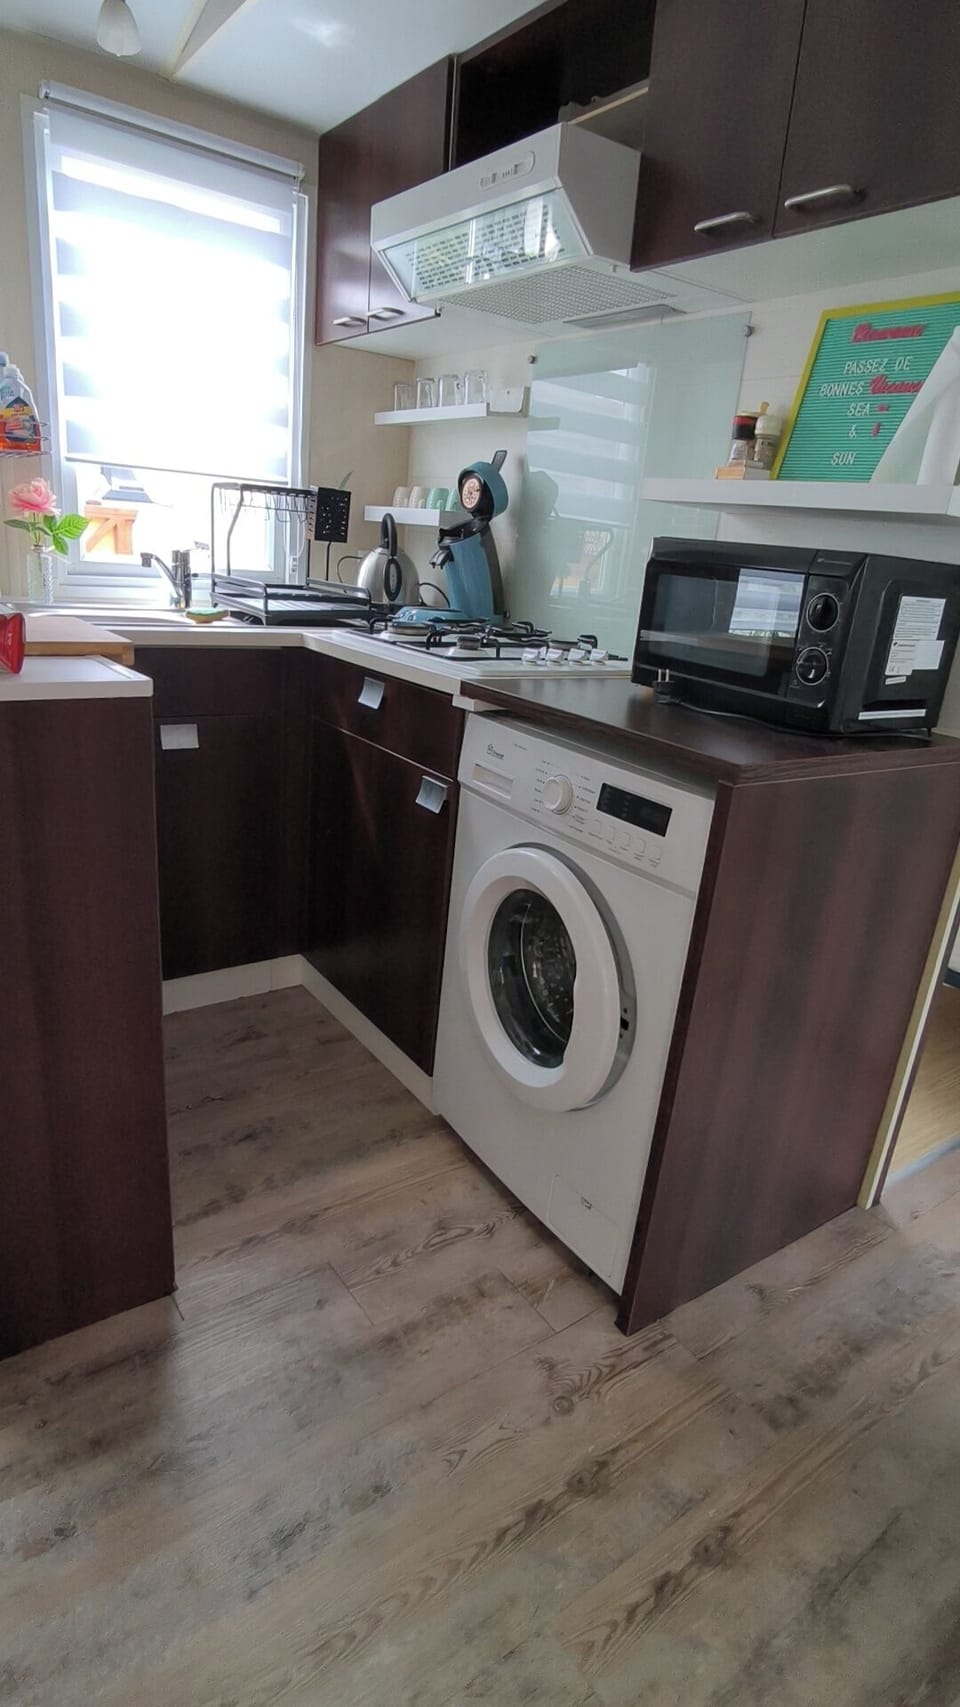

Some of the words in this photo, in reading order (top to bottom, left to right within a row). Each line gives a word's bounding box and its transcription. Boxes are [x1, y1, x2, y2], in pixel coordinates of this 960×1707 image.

[843, 358, 889, 375] PASSEZ
[894, 356, 913, 371] DE
[819, 380, 865, 397] BONNES
[847, 403, 870, 417] SEA
[849, 423, 857, 438] &
[830, 451, 857, 466] SUN
